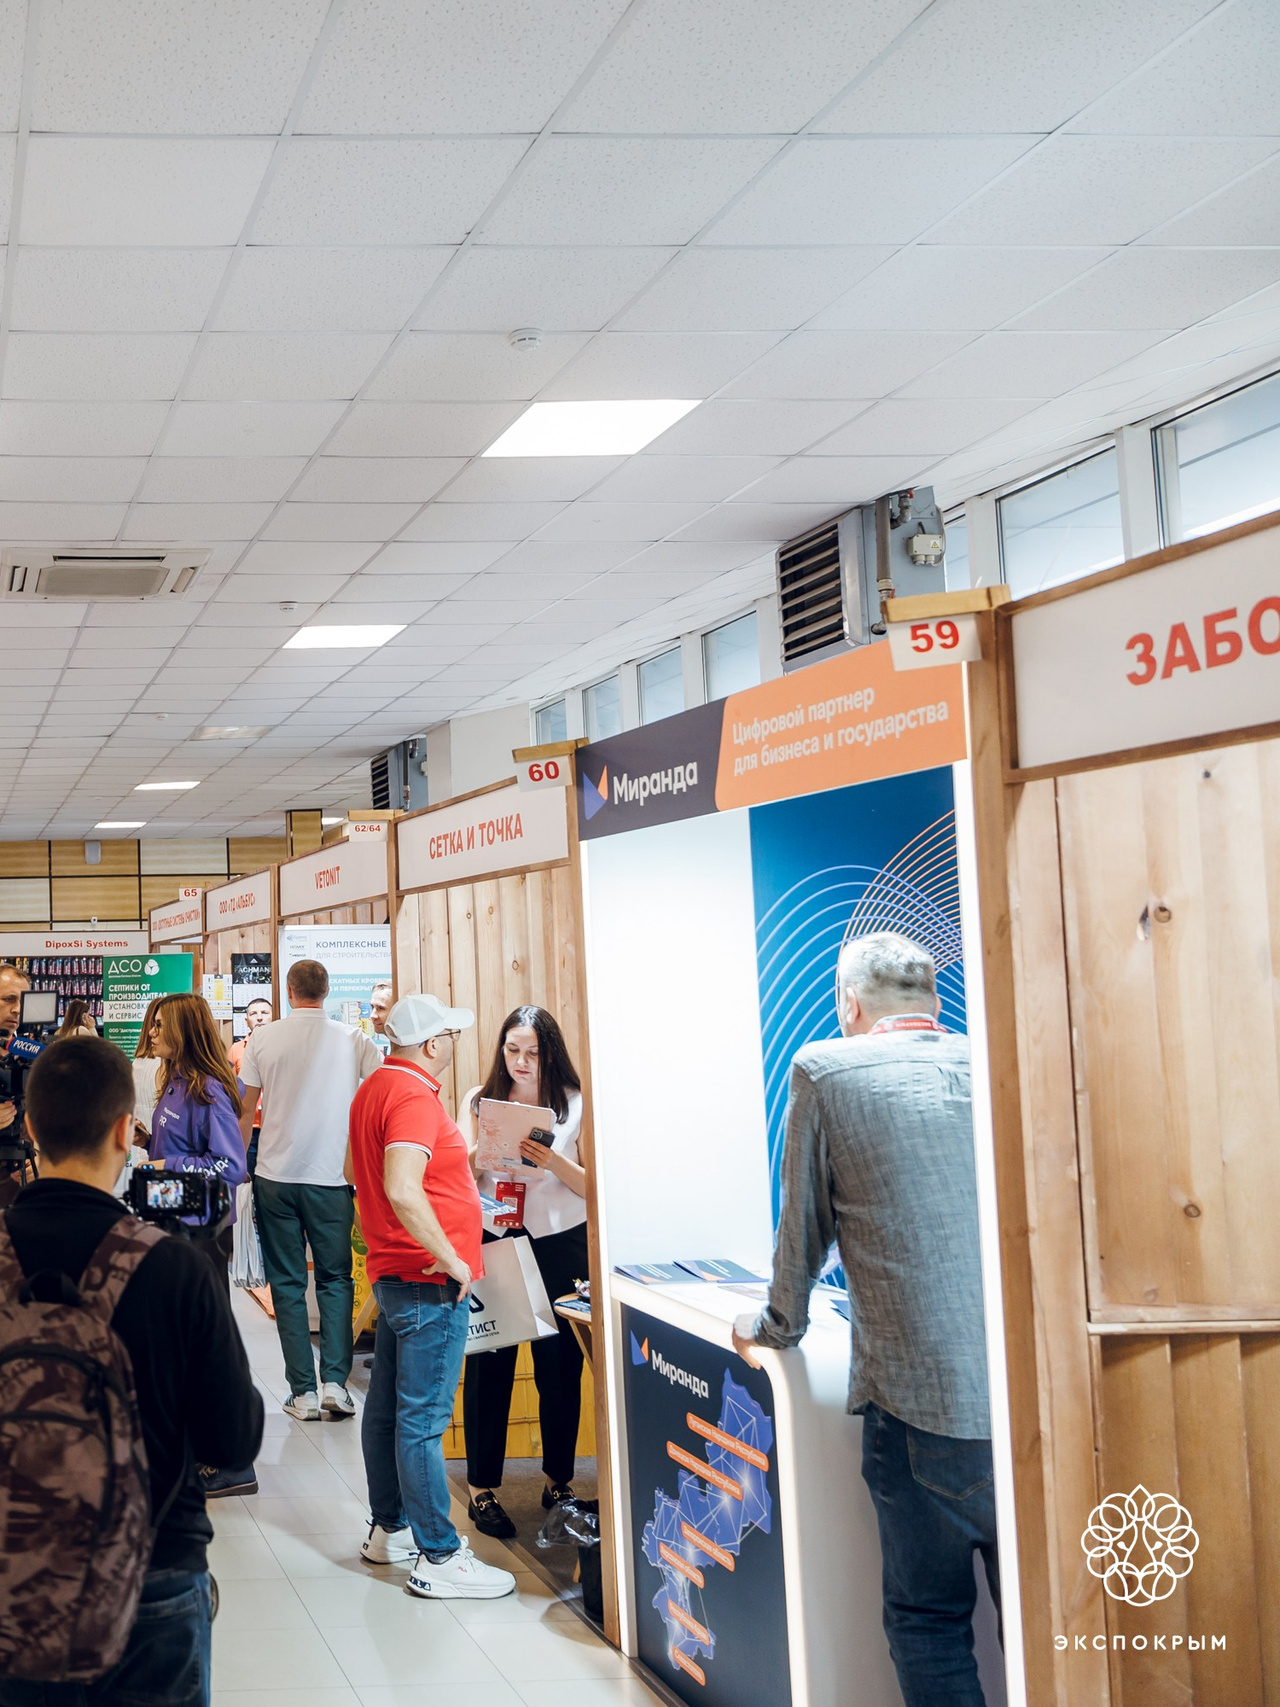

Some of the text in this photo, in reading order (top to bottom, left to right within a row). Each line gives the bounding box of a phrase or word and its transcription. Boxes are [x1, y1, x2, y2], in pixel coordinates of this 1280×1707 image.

[910, 620, 960, 653] 59
[1125, 595, 1280, 687] ЗАБО
[732, 687, 875, 745] Цифровой партнер
[733, 701, 949, 777] для бизнеса и государства
[528, 760, 559, 782] 60
[613, 760, 698, 806] Миранда
[354, 823, 381, 834] 62/64
[429, 813, 523, 860] СЕТКА И ТОЧКА
[315, 866, 341, 891] VETONIT
[183, 888, 198, 897] 65
[45, 939, 128, 949] DipoxSi Systems
[315, 940, 387, 949] КОМПЛЕКСНЫЕ
[109, 983, 150, 992] СЕПТИКИ ОТ
[109, 1012, 143, 1020] И СЕРВИС
[13, 1039, 41, 1055] РОССИЯ
[651, 1349, 709, 1399] Миранда
